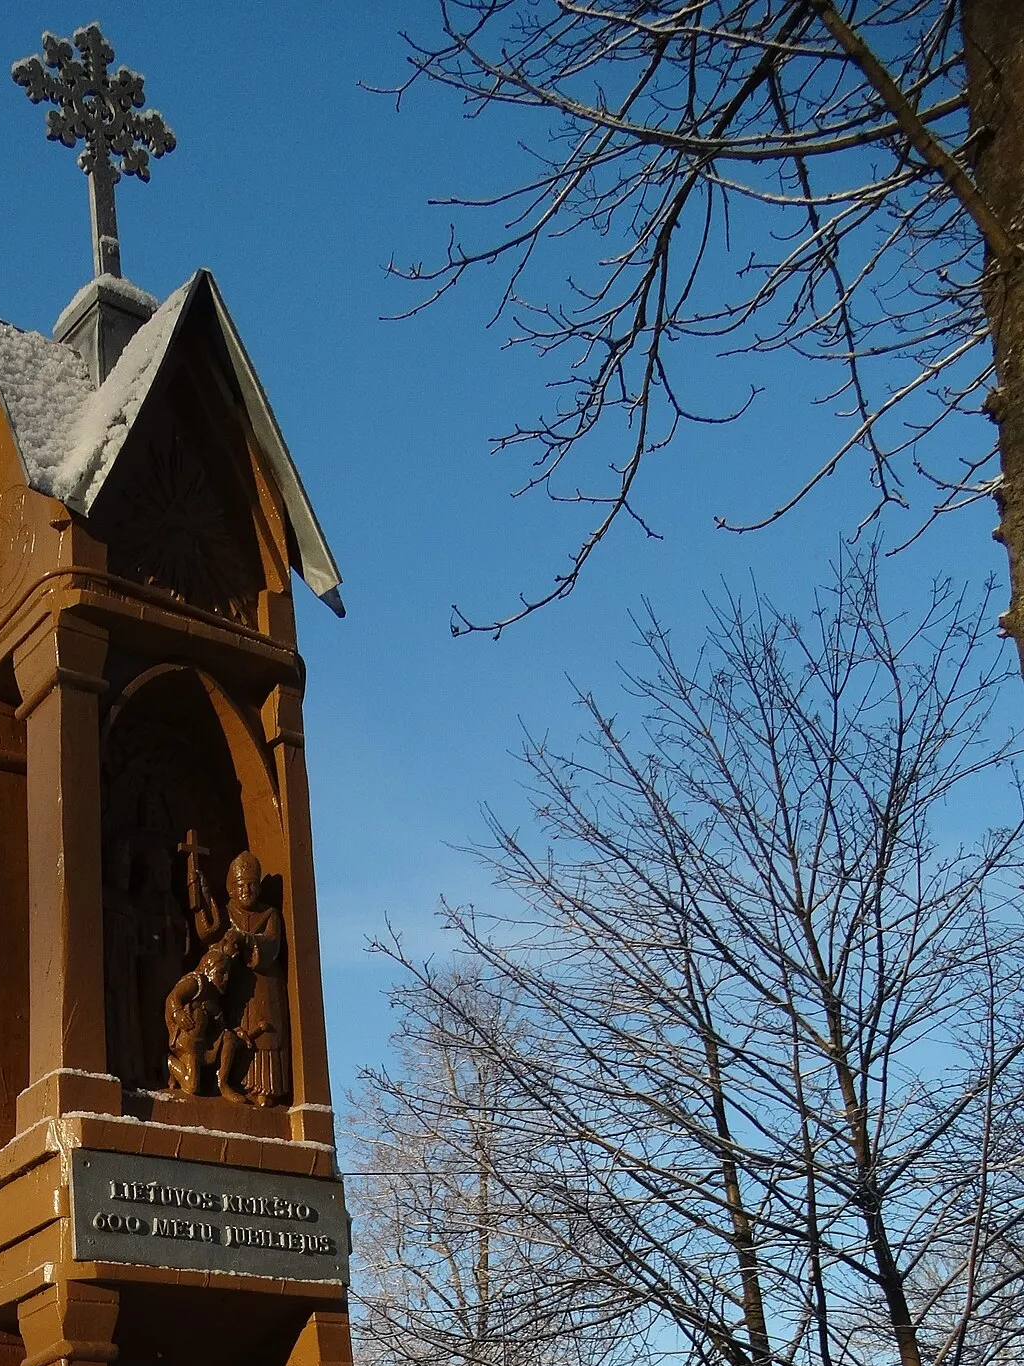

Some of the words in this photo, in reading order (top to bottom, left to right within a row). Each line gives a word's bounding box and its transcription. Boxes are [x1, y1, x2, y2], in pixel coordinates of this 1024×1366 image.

[110, 1180, 213, 1209] LIETUVOS
[222, 1193, 310, 1220] KRIKŠTO
[92, 1212, 140, 1232] 600
[225, 1225, 330, 1254] JUBILIEJUS
